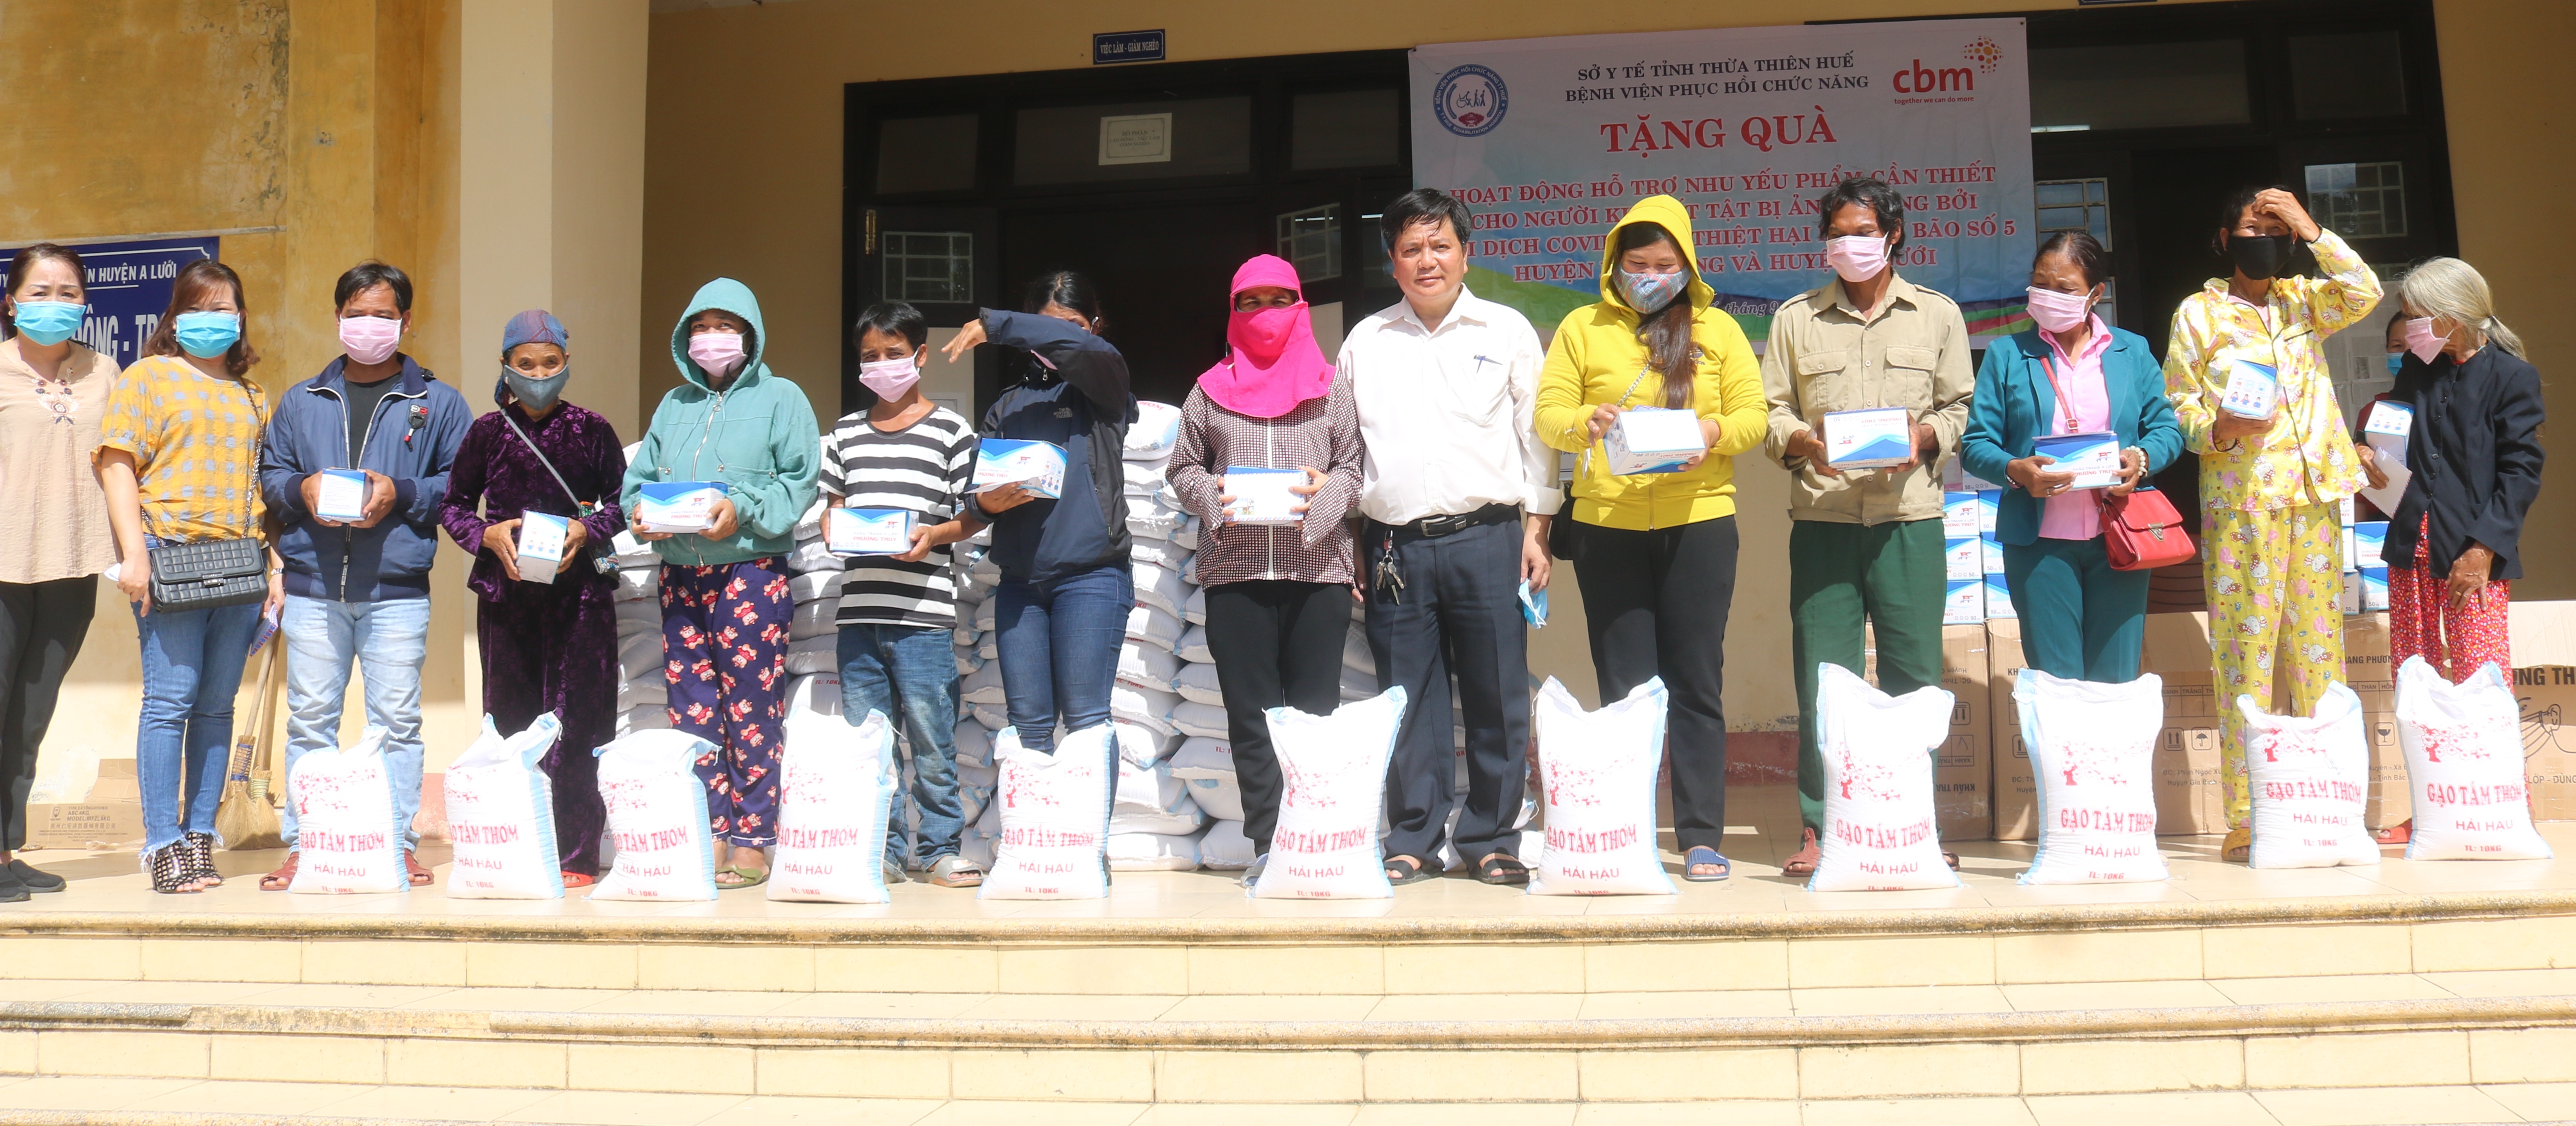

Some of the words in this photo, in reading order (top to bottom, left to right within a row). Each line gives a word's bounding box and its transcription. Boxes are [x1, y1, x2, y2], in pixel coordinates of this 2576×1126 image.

[1100, 42, 1112, 55] VIỆC
[1113, 41, 1124, 53] LÀM
[1128, 39, 1141, 52] GIẢM
[1142, 39, 1159, 51] NGHÈO
[1578, 64, 1600, 81] SỞ
[1606, 67, 1617, 79] Y
[1622, 60, 1645, 78] TẾ
[1651, 60, 1694, 77] TỈNH
[1700, 58, 1750, 75] THỪA
[1754, 55, 1811, 71] THIÊN
[1816, 51, 1855, 68] HUẾ
[1893, 59, 1973, 93] cbm
[1565, 86, 1615, 104] BỆNH
[1620, 83, 1663, 102] VIỆN
[1669, 82, 1719, 98] PHỤC
[1723, 75, 1757, 94] HỒI
[1762, 76, 1813, 92] CHỨC
[1818, 75, 1869, 89] NĂNG
[1894, 97, 1922, 105] together
[1600, 113, 1727, 159] TẶNG
[1740, 104, 1838, 152] QUÀ
[1450, 186, 1513, 206] HOẠT
[1519, 181, 1584, 206] ĐỘNG
[1590, 173, 1624, 198] HỖ
[1631, 176, 1678, 197] TRỢ
[1685, 176, 1735, 193] NHU
[1741, 167, 1788, 191] YẾU
[1925, 159, 1997, 184] THIẾT
[1472, 212, 1518, 231] CHO
[1524, 204, 1598, 228] NGƯỜI
[1706, 197, 1751, 220] TẬT
[1758, 200, 1781, 220] BỊ
[1936, 188, 1978, 210] BỞI
[1483, 237, 1539, 258] DỊCH
[1692, 225, 1761, 250] THIỆT
[1768, 226, 1811, 247] HẠI
[1912, 217, 1961, 239] BÃO
[1967, 213, 1997, 237] SỐ
[2004, 220, 2016, 235] 5
[98, 262, 136, 284] HUYỆN
[140, 265, 147, 280] A
[150, 259, 177, 279] LƯỚI
[1513, 259, 1594, 284] HUYỆN
[1731, 250, 1763, 272] VÀ
[1725, 302, 1766, 317] tháng
